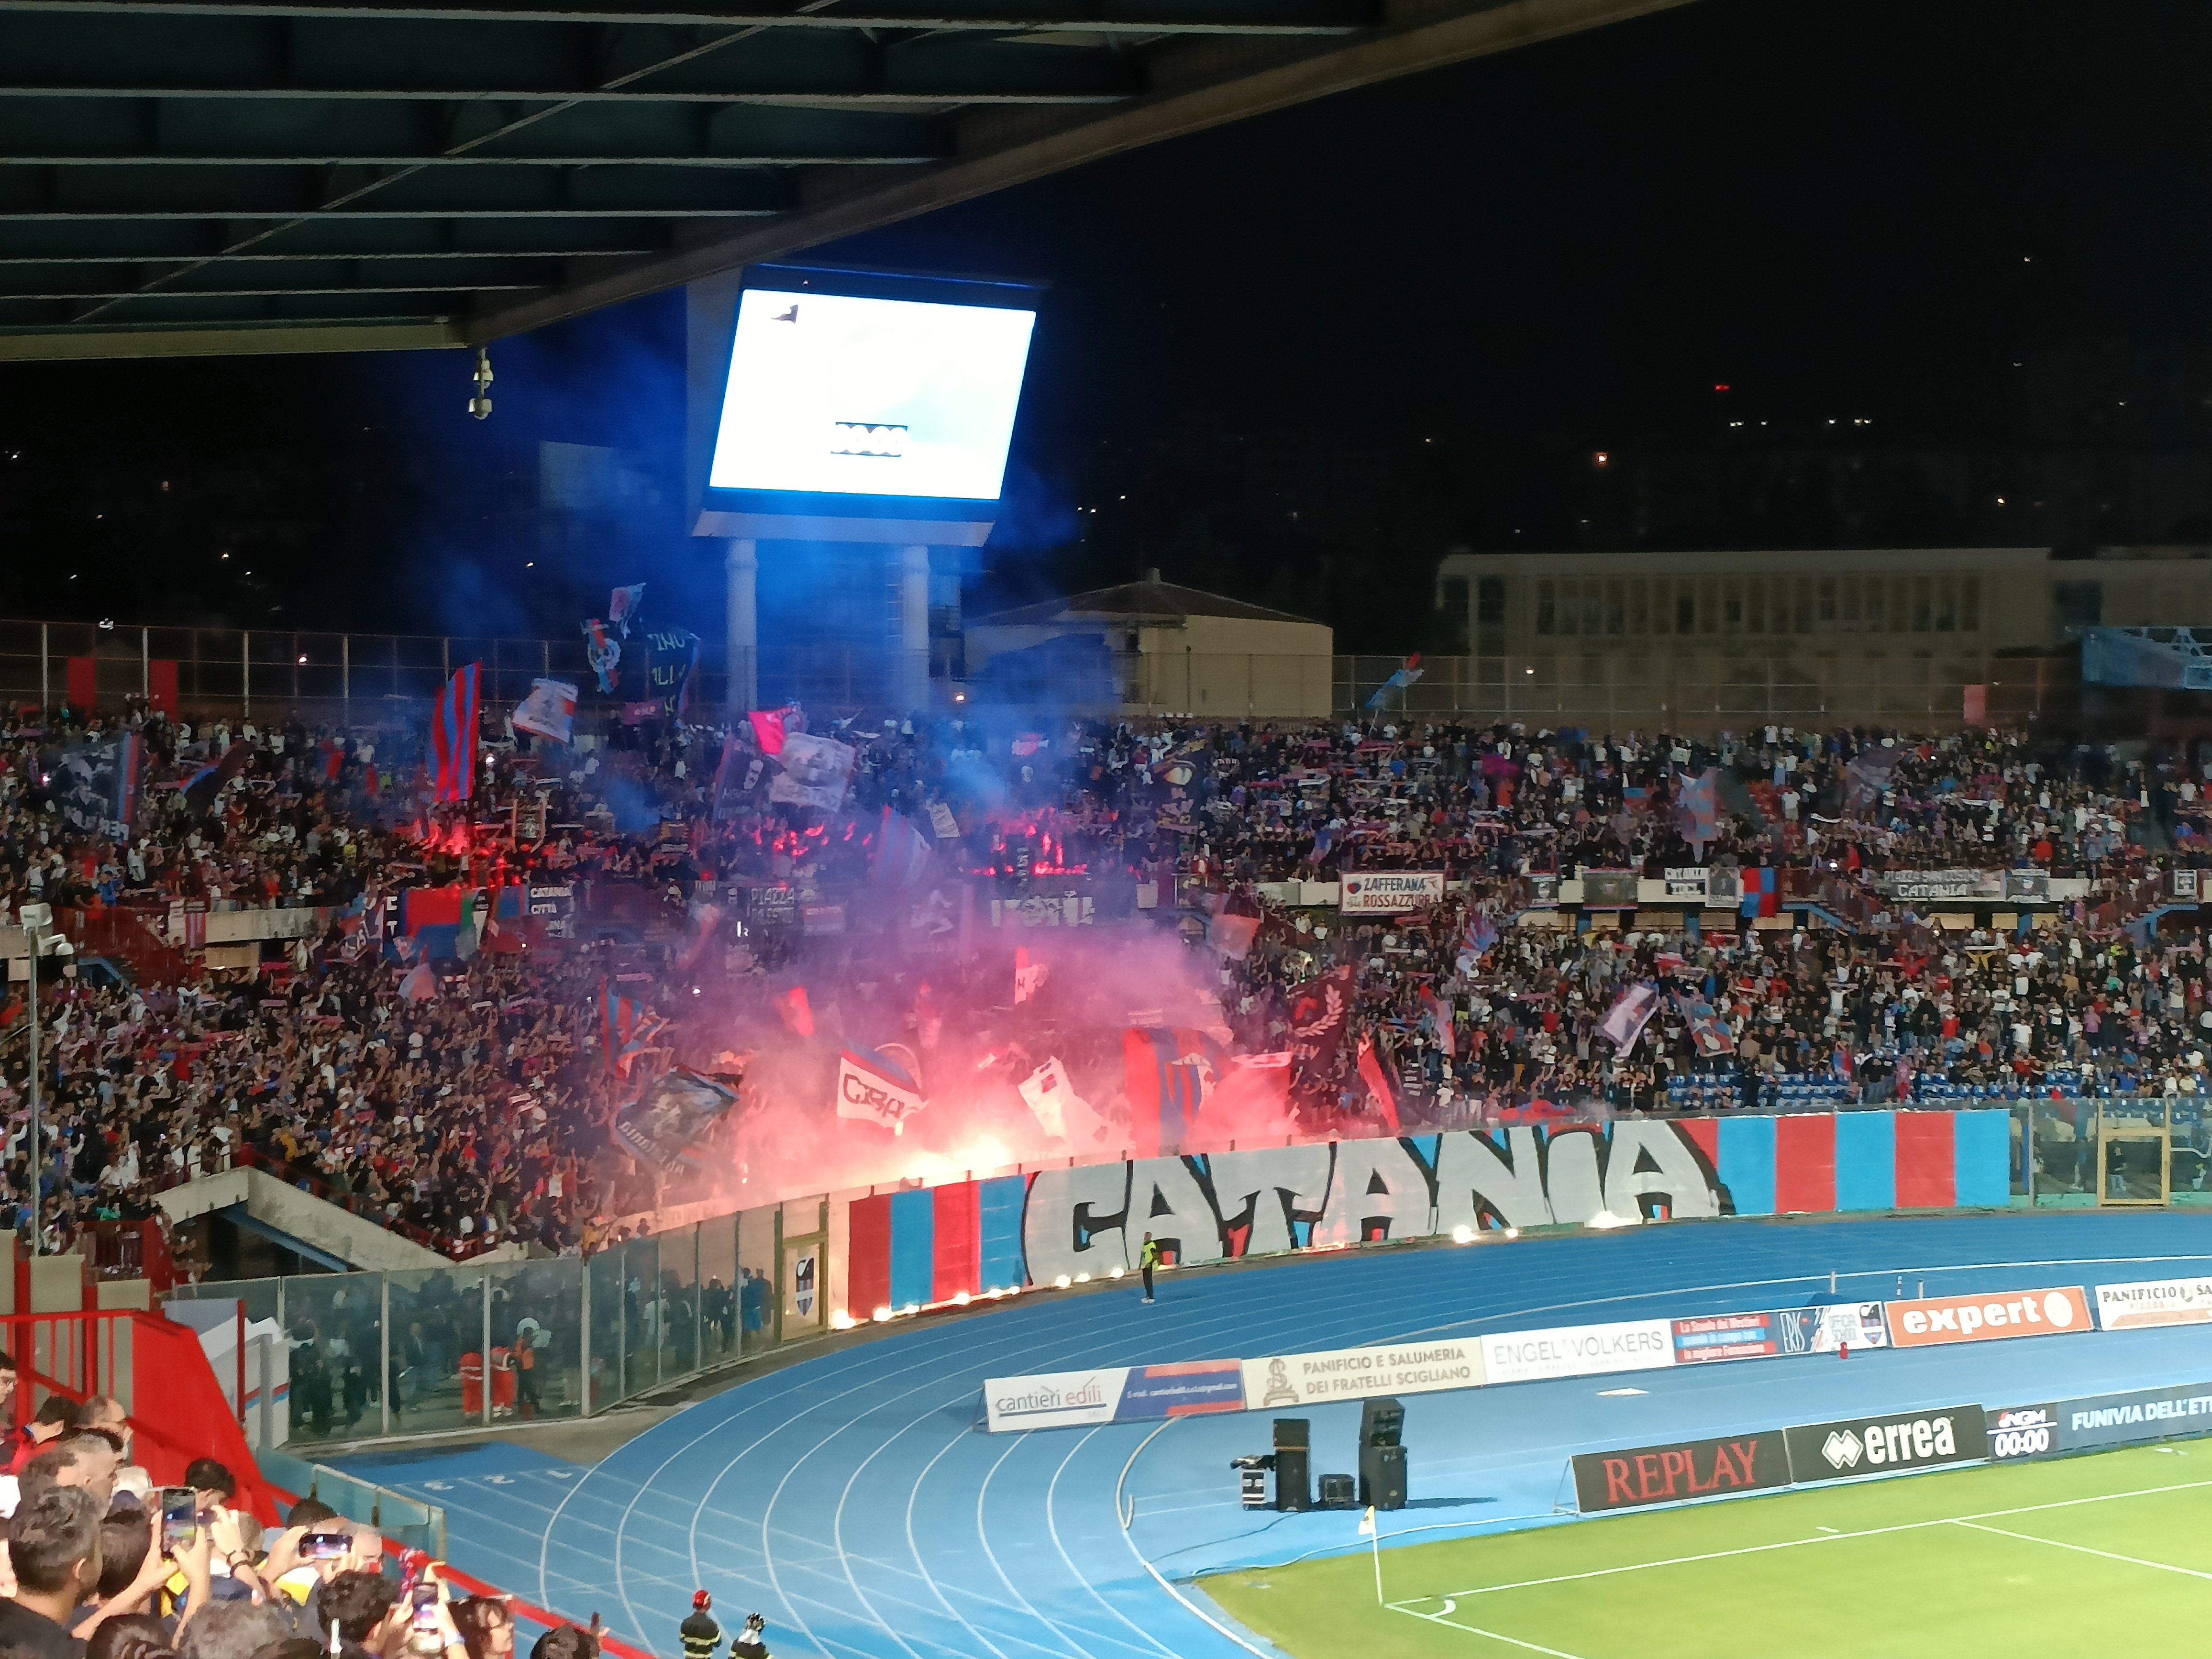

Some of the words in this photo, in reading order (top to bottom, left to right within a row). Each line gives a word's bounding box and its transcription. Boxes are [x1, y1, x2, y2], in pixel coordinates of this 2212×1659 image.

[1897, 884, 1967, 897] CATANIA
[1023, 1118, 1736, 1286] CATANIA
[2102, 1286, 2177, 1303] PANIFICIO
[1902, 1296, 2041, 1335] expert
[1303, 1356, 1372, 1375] PANIFICIO
[1376, 1355, 1385, 1367] E
[1388, 1348, 1466, 1367] SALUMERIA
[1493, 1340, 1562, 1365] ENGEL
[1571, 1331, 1664, 1357] VÖLKERS
[1306, 1381, 1328, 1394] DEI
[1333, 1374, 1392, 1391] FRATELLI
[1396, 1365, 1471, 1385] SCIGLIANO
[995, 1387, 1061, 1413] cantieri
[1065, 1382, 1102, 1405] edili
[2071, 1404, 2144, 1431] FUNIVIA
[2145, 1395, 2212, 1421] DELL'ET
[1994, 1427, 2050, 1458] 00:00
[1602, 1439, 1758, 1504] REPLAY
